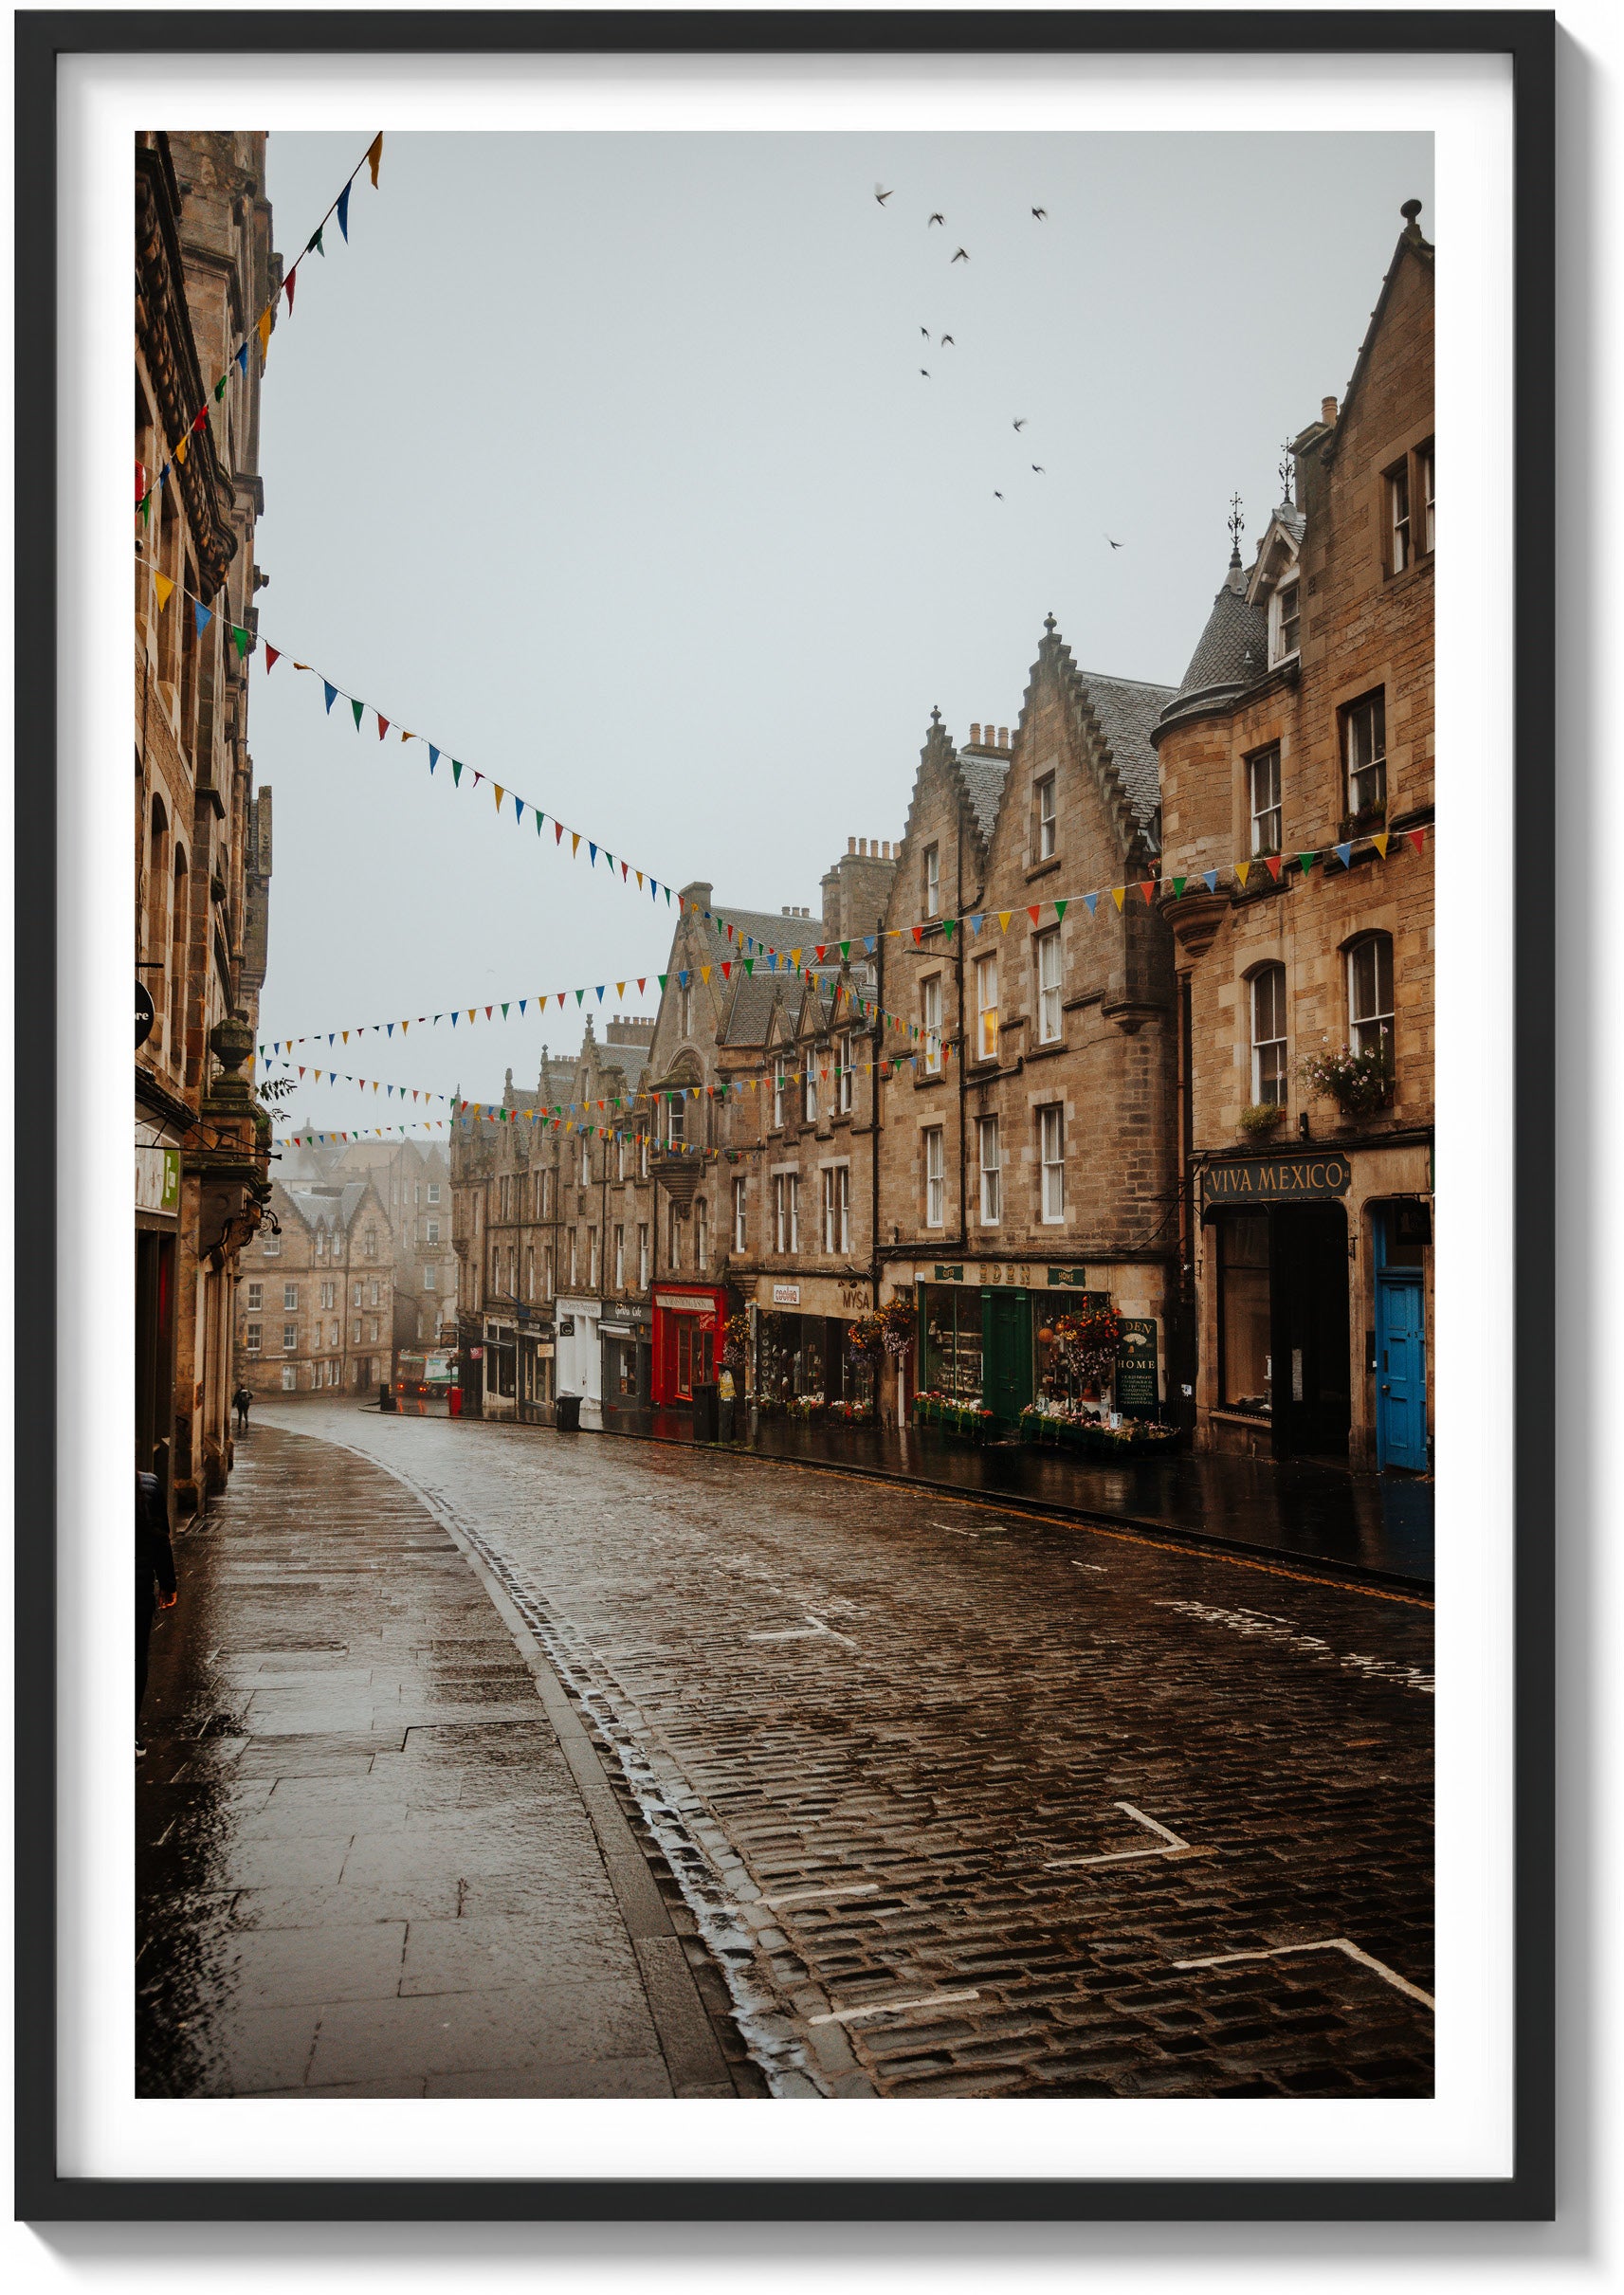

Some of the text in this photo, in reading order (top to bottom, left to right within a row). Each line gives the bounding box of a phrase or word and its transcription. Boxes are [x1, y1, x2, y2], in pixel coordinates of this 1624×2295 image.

[1211, 1162, 1343, 1192] VIVA MEXICO
[979, 1264, 1031, 1285] EDEN
[1058, 1272, 1074, 1282] HOME
[843, 1289, 870, 1310] MYSA
[1124, 1321, 1153, 1335] DEN
[1117, 1359, 1156, 1370] HOME
